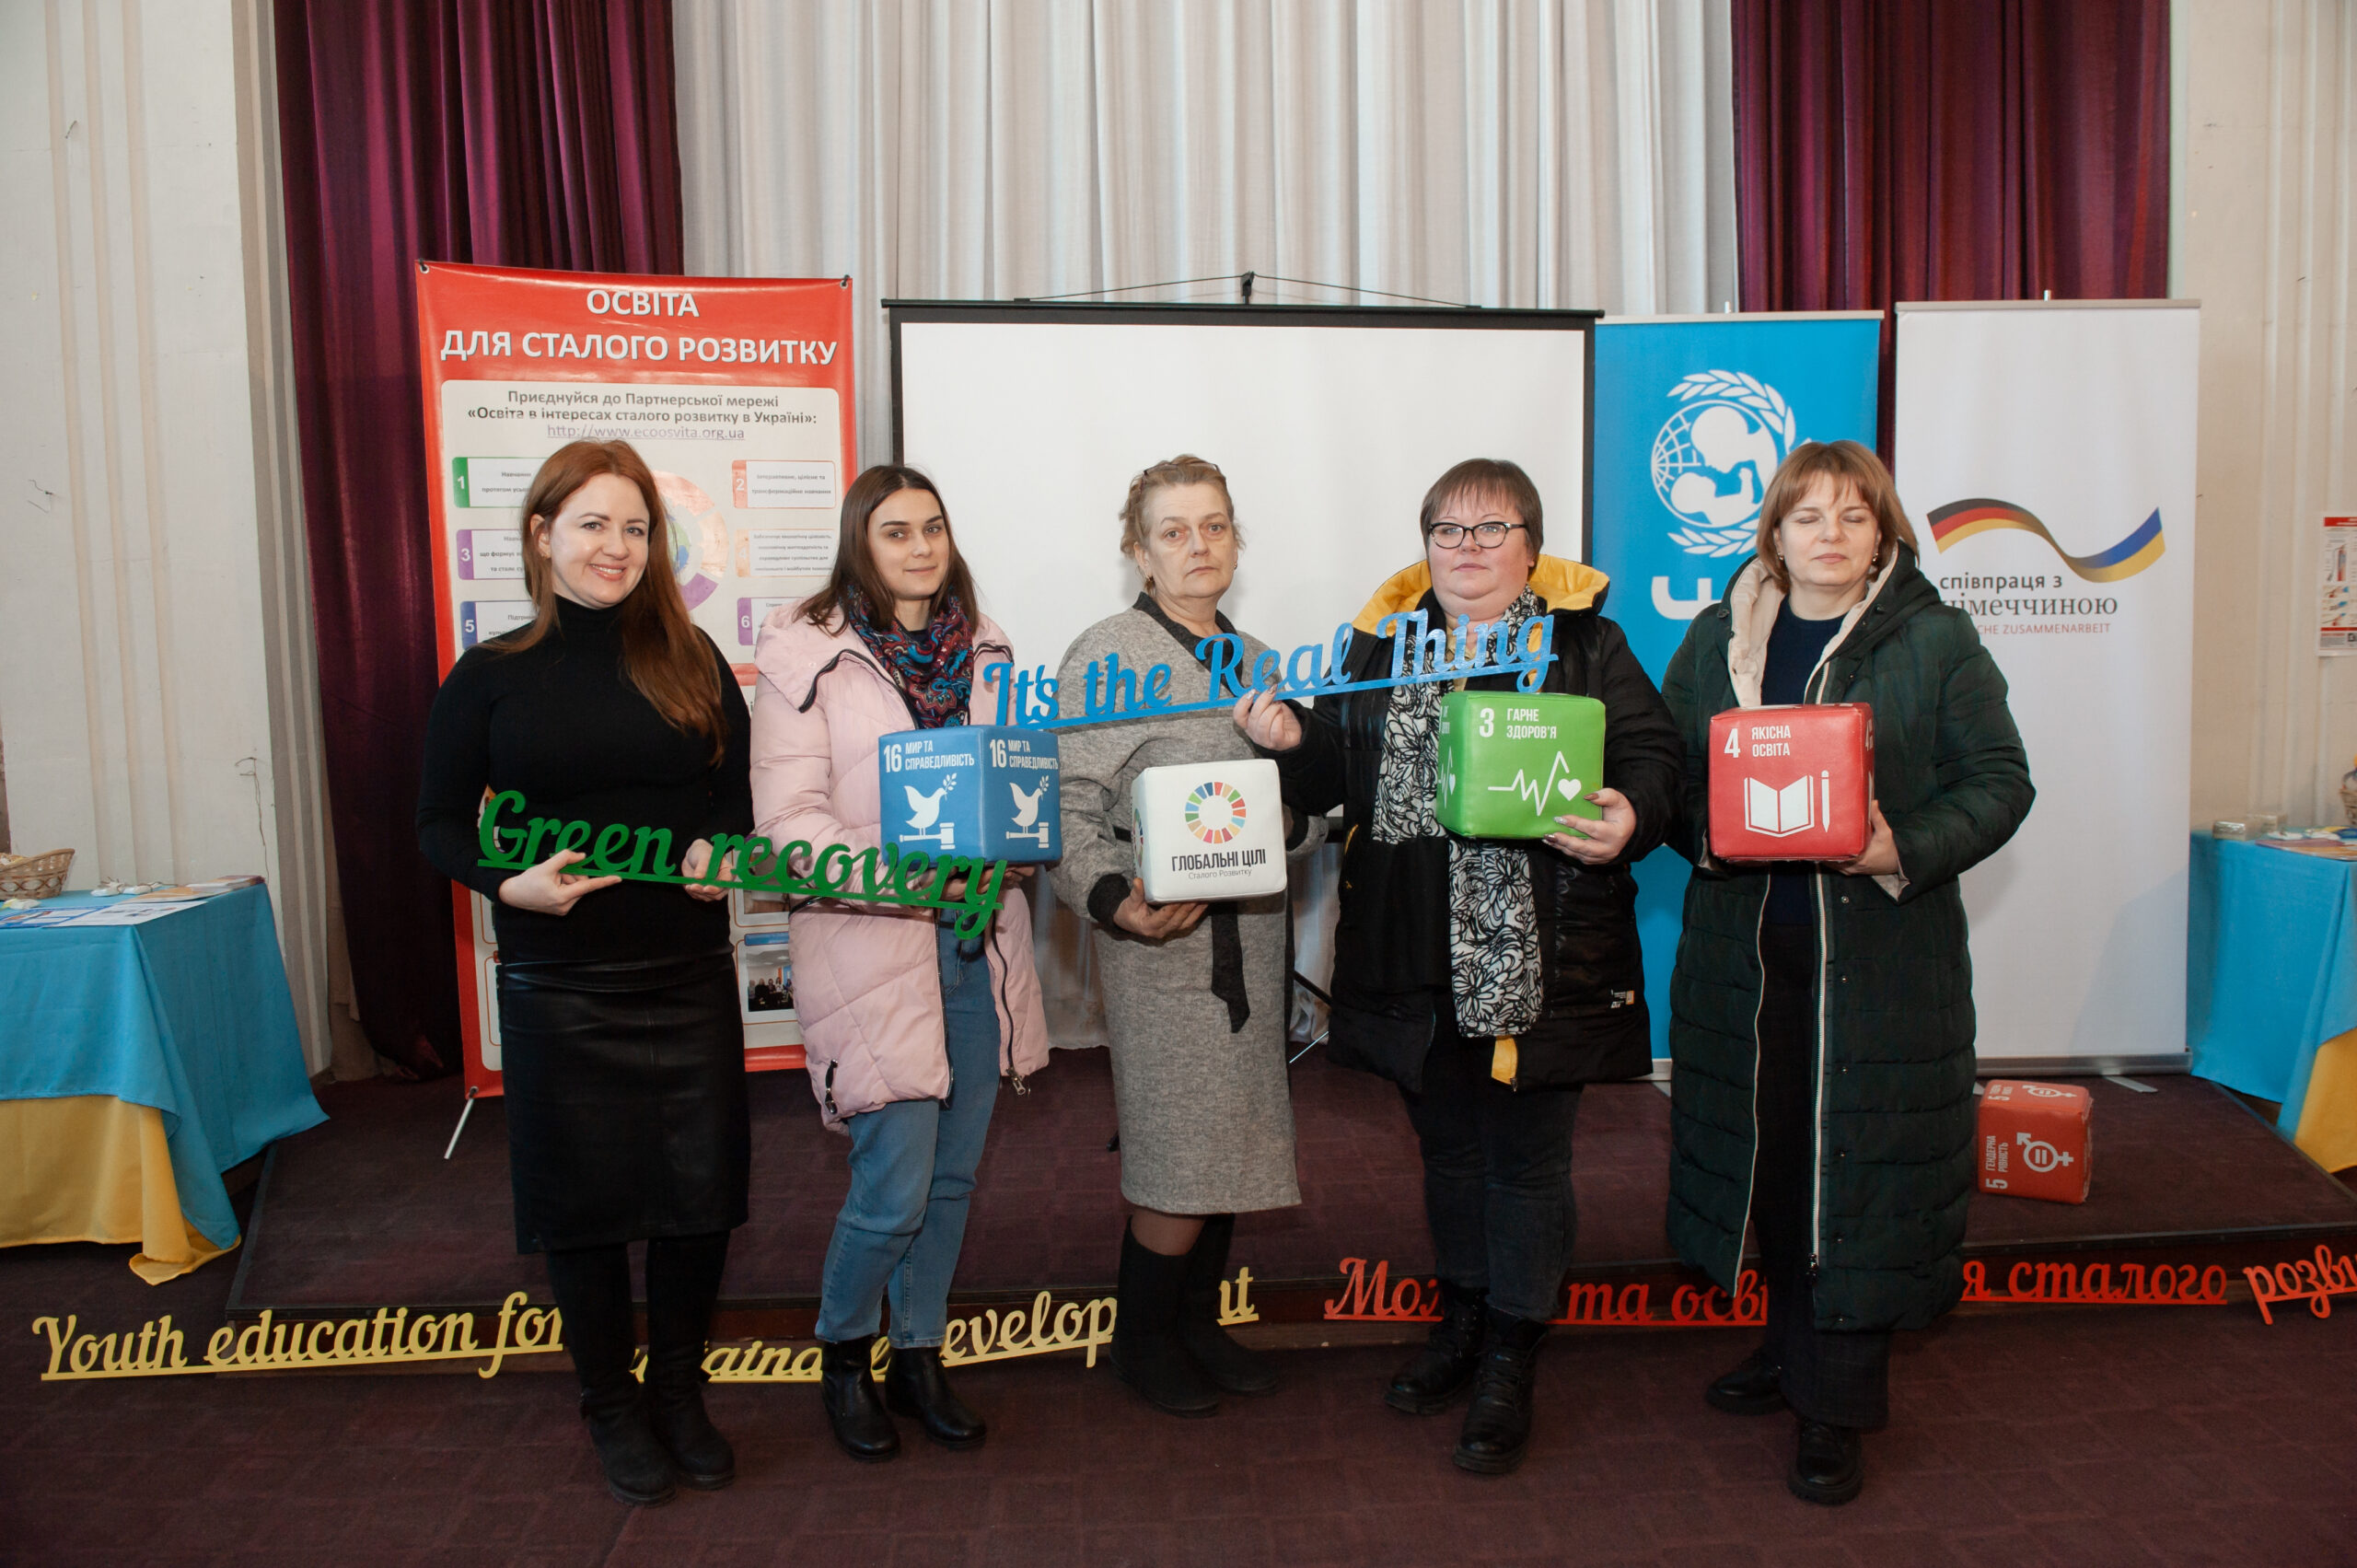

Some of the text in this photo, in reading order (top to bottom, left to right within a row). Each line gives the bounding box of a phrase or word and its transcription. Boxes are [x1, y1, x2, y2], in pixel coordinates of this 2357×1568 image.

[586, 288, 700, 318] ОСВІТА
[440, 330, 837, 366] ДЛЯ СТАЛОГО РОЗВИТКУ
[508, 390, 779, 409] Приєднуйся до Партнерської мережі
[468, 406, 817, 425] «Освіта в інтересах сталого розвитку в Україні»:
[547, 424, 745, 441] http://www.ecoosvita.org.ua
[458, 476, 465, 490] 1
[736, 479, 745, 491] 2
[460, 548, 470, 562] 3
[1940, 572, 2062, 594] співпраця з
[465, 620, 475, 633] 5
[741, 615, 750, 628] 6
[2003, 623, 2111, 634] ZUSAMMENARBEIT
[1083, 653, 1172, 718] the
[1195, 622, 1353, 702] Real
[1376, 608, 1559, 693] Thing
[1479, 707, 1495, 738] 3
[1506, 708, 1539, 722] ГАРНЕ
[1506, 725, 1557, 739] ЗДОРОВ'Я
[1751, 725, 1792, 740] ЯКІСНА
[905, 740, 934, 754] МИР ТА
[1007, 739, 1031, 753] МИР ТА
[1724, 728, 1741, 758] 4
[1752, 743, 1791, 758] ОСВІТА
[883, 743, 902, 772] 16
[905, 753, 975, 771] СПРАВЕДЛИВІСТЬ
[990, 738, 1007, 768] 16
[1009, 755, 1059, 771] СПРАВЕДЛИВІСТЬ
[478, 789, 1008, 940] Green recovery
[1171, 849, 1266, 872] ГЛОБАЛЬНІ ЦІЛІ
[1188, 868, 1252, 880] Сталого Розвитку
[1985, 1135, 1996, 1171] ГЕНДЕРНА
[1998, 1142, 2009, 1172] РІВНІСТЬ
[1985, 1178, 2008, 1190] 5
[1566, 1283, 1654, 1325] та
[2008, 1260, 2227, 1305] сталого
[32, 1314, 188, 1379] Youth
[203, 1307, 477, 1369] education
[478, 1291, 563, 1378] for
